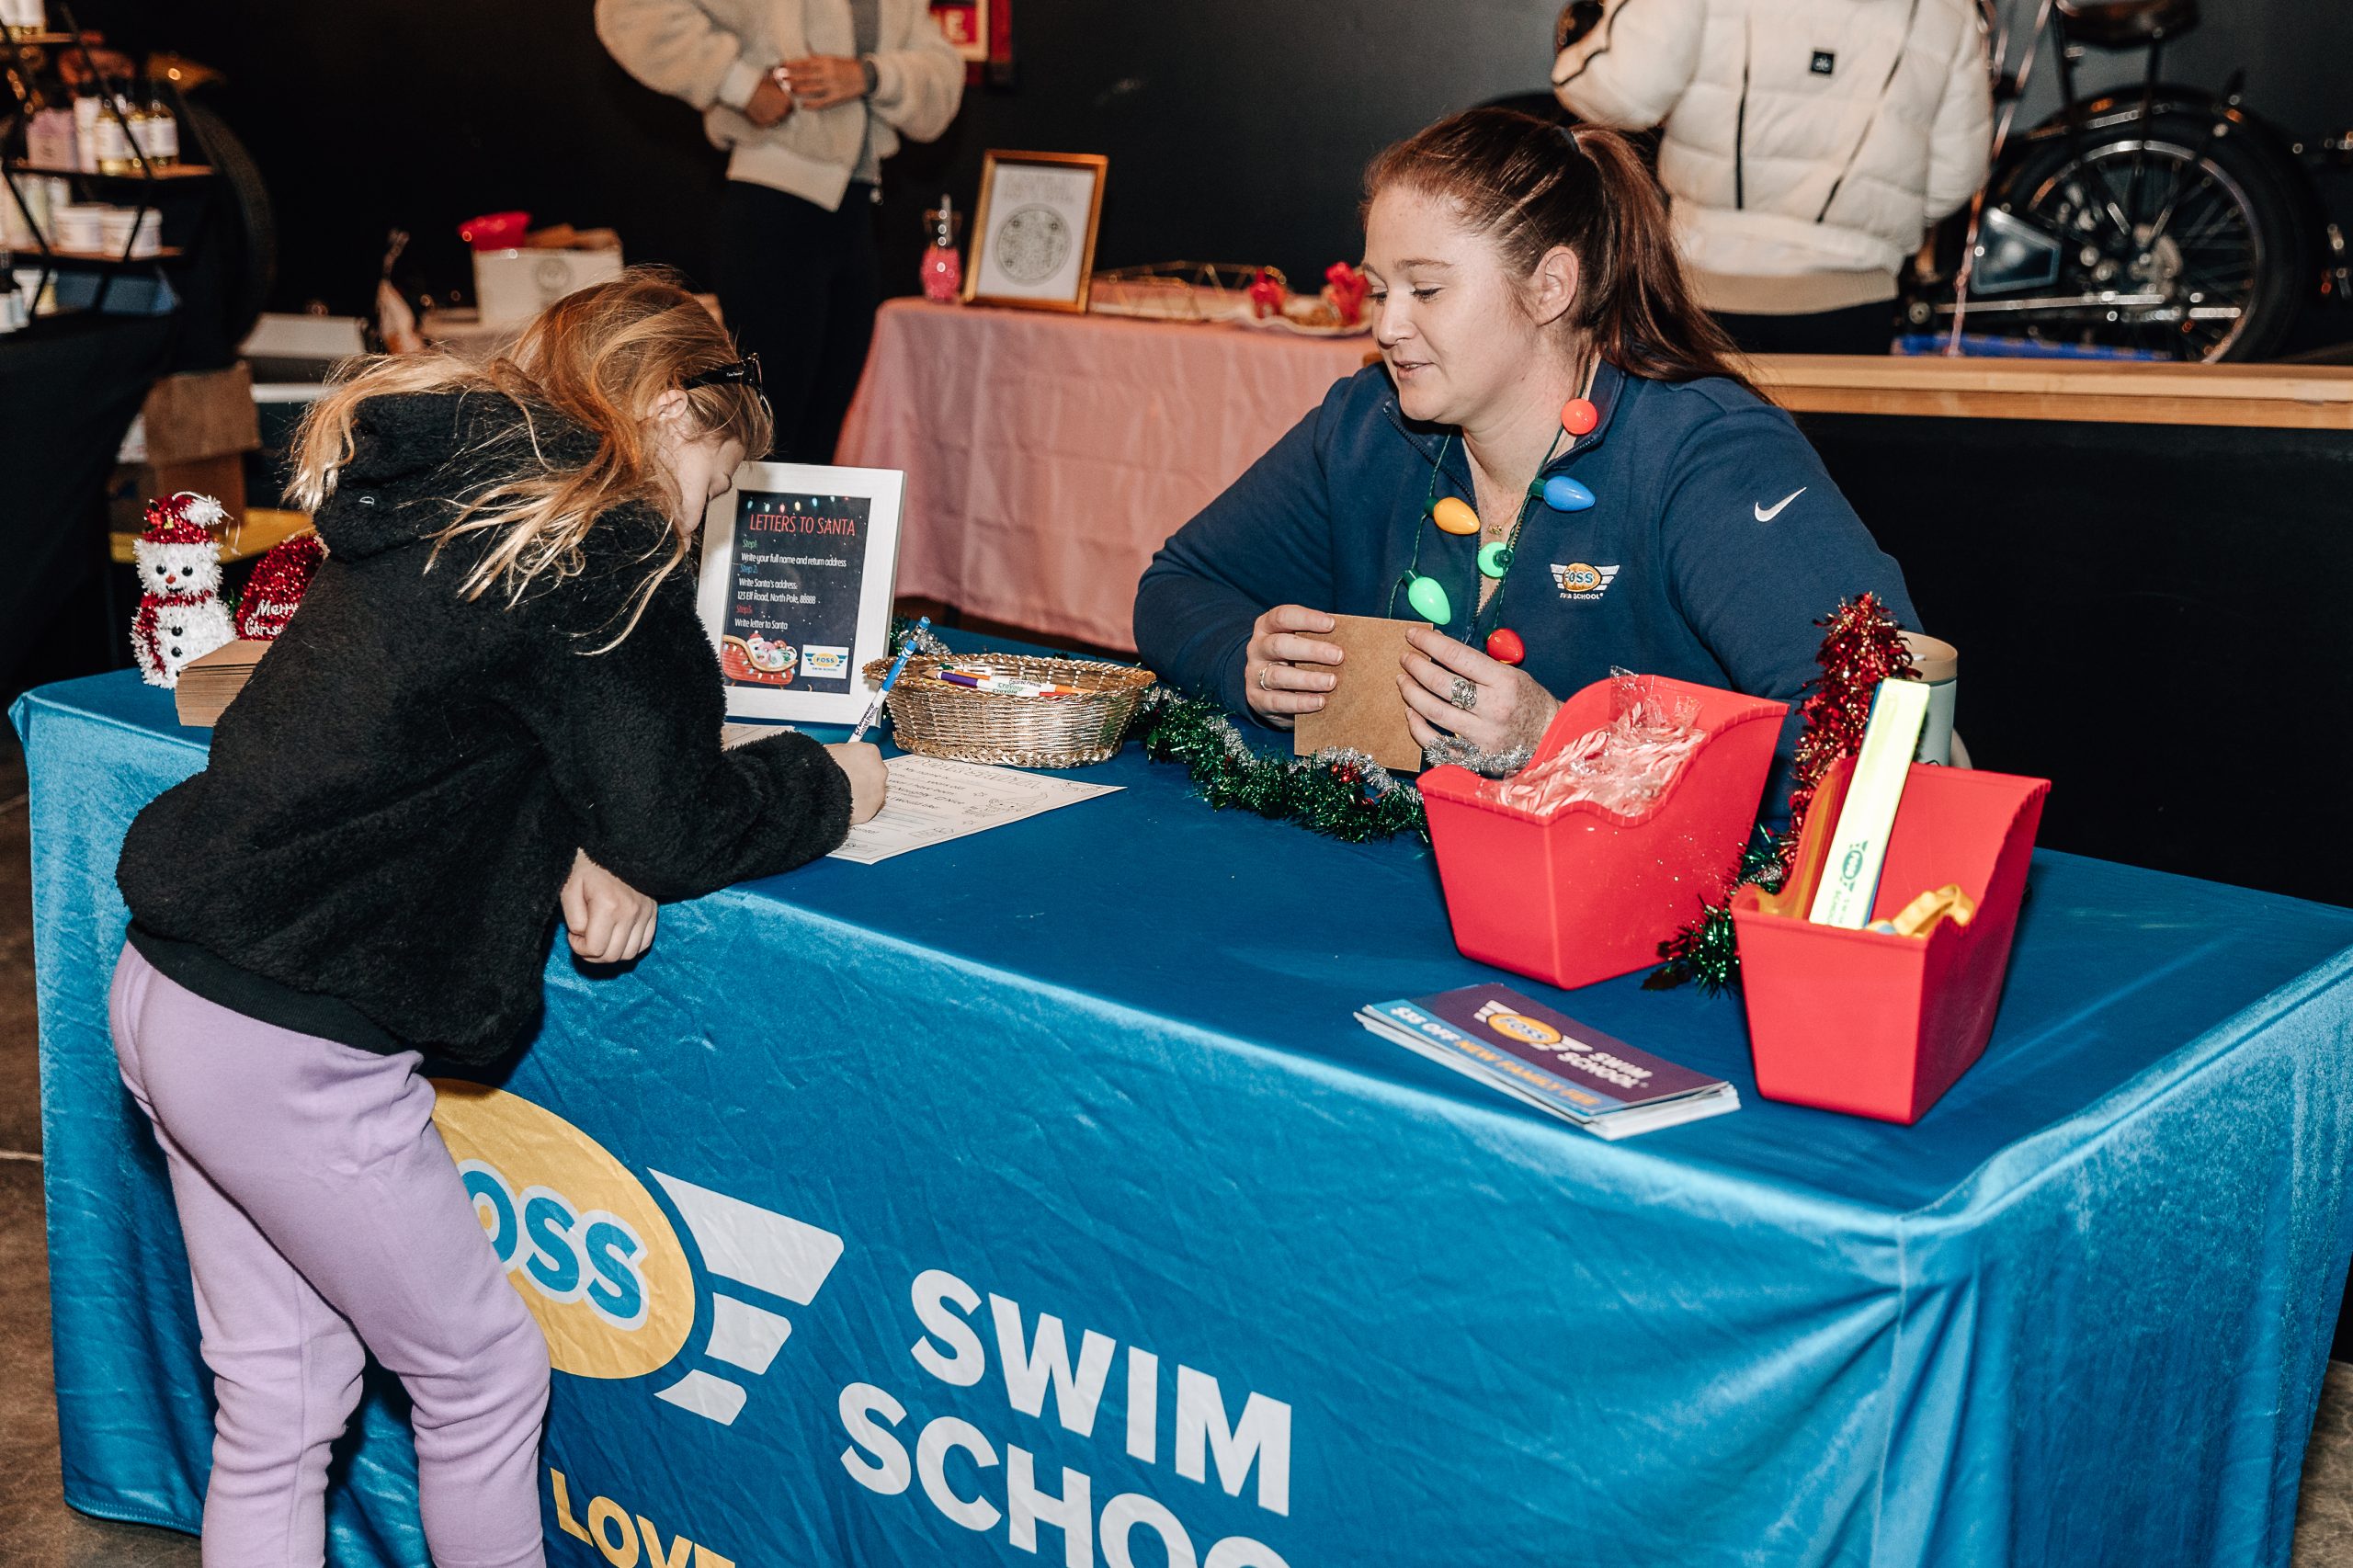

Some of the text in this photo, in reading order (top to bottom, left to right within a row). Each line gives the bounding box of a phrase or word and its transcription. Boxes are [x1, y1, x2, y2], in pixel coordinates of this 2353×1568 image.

[749, 514, 856, 536] LETTERS TO SANTA
[741, 552, 847, 567] Write your full name and return address
[739, 577, 754, 586] Write
[755, 578, 774, 588] Santa's
[737, 591, 745, 600] 123
[745, 591, 754, 600] Elf
[754, 592, 769, 602] Road,
[770, 593, 786, 602] North
[251, 598, 299, 619] Merry
[735, 619, 788, 630] Write letter to Santa
[1497, 1017, 1551, 1040] FOSS
[1588, 1051, 1654, 1079] SWIM
[460, 1159, 648, 1331] OSS
[910, 1269, 1291, 1517] SWIM
[838, 1382, 1290, 1568] SCHO
